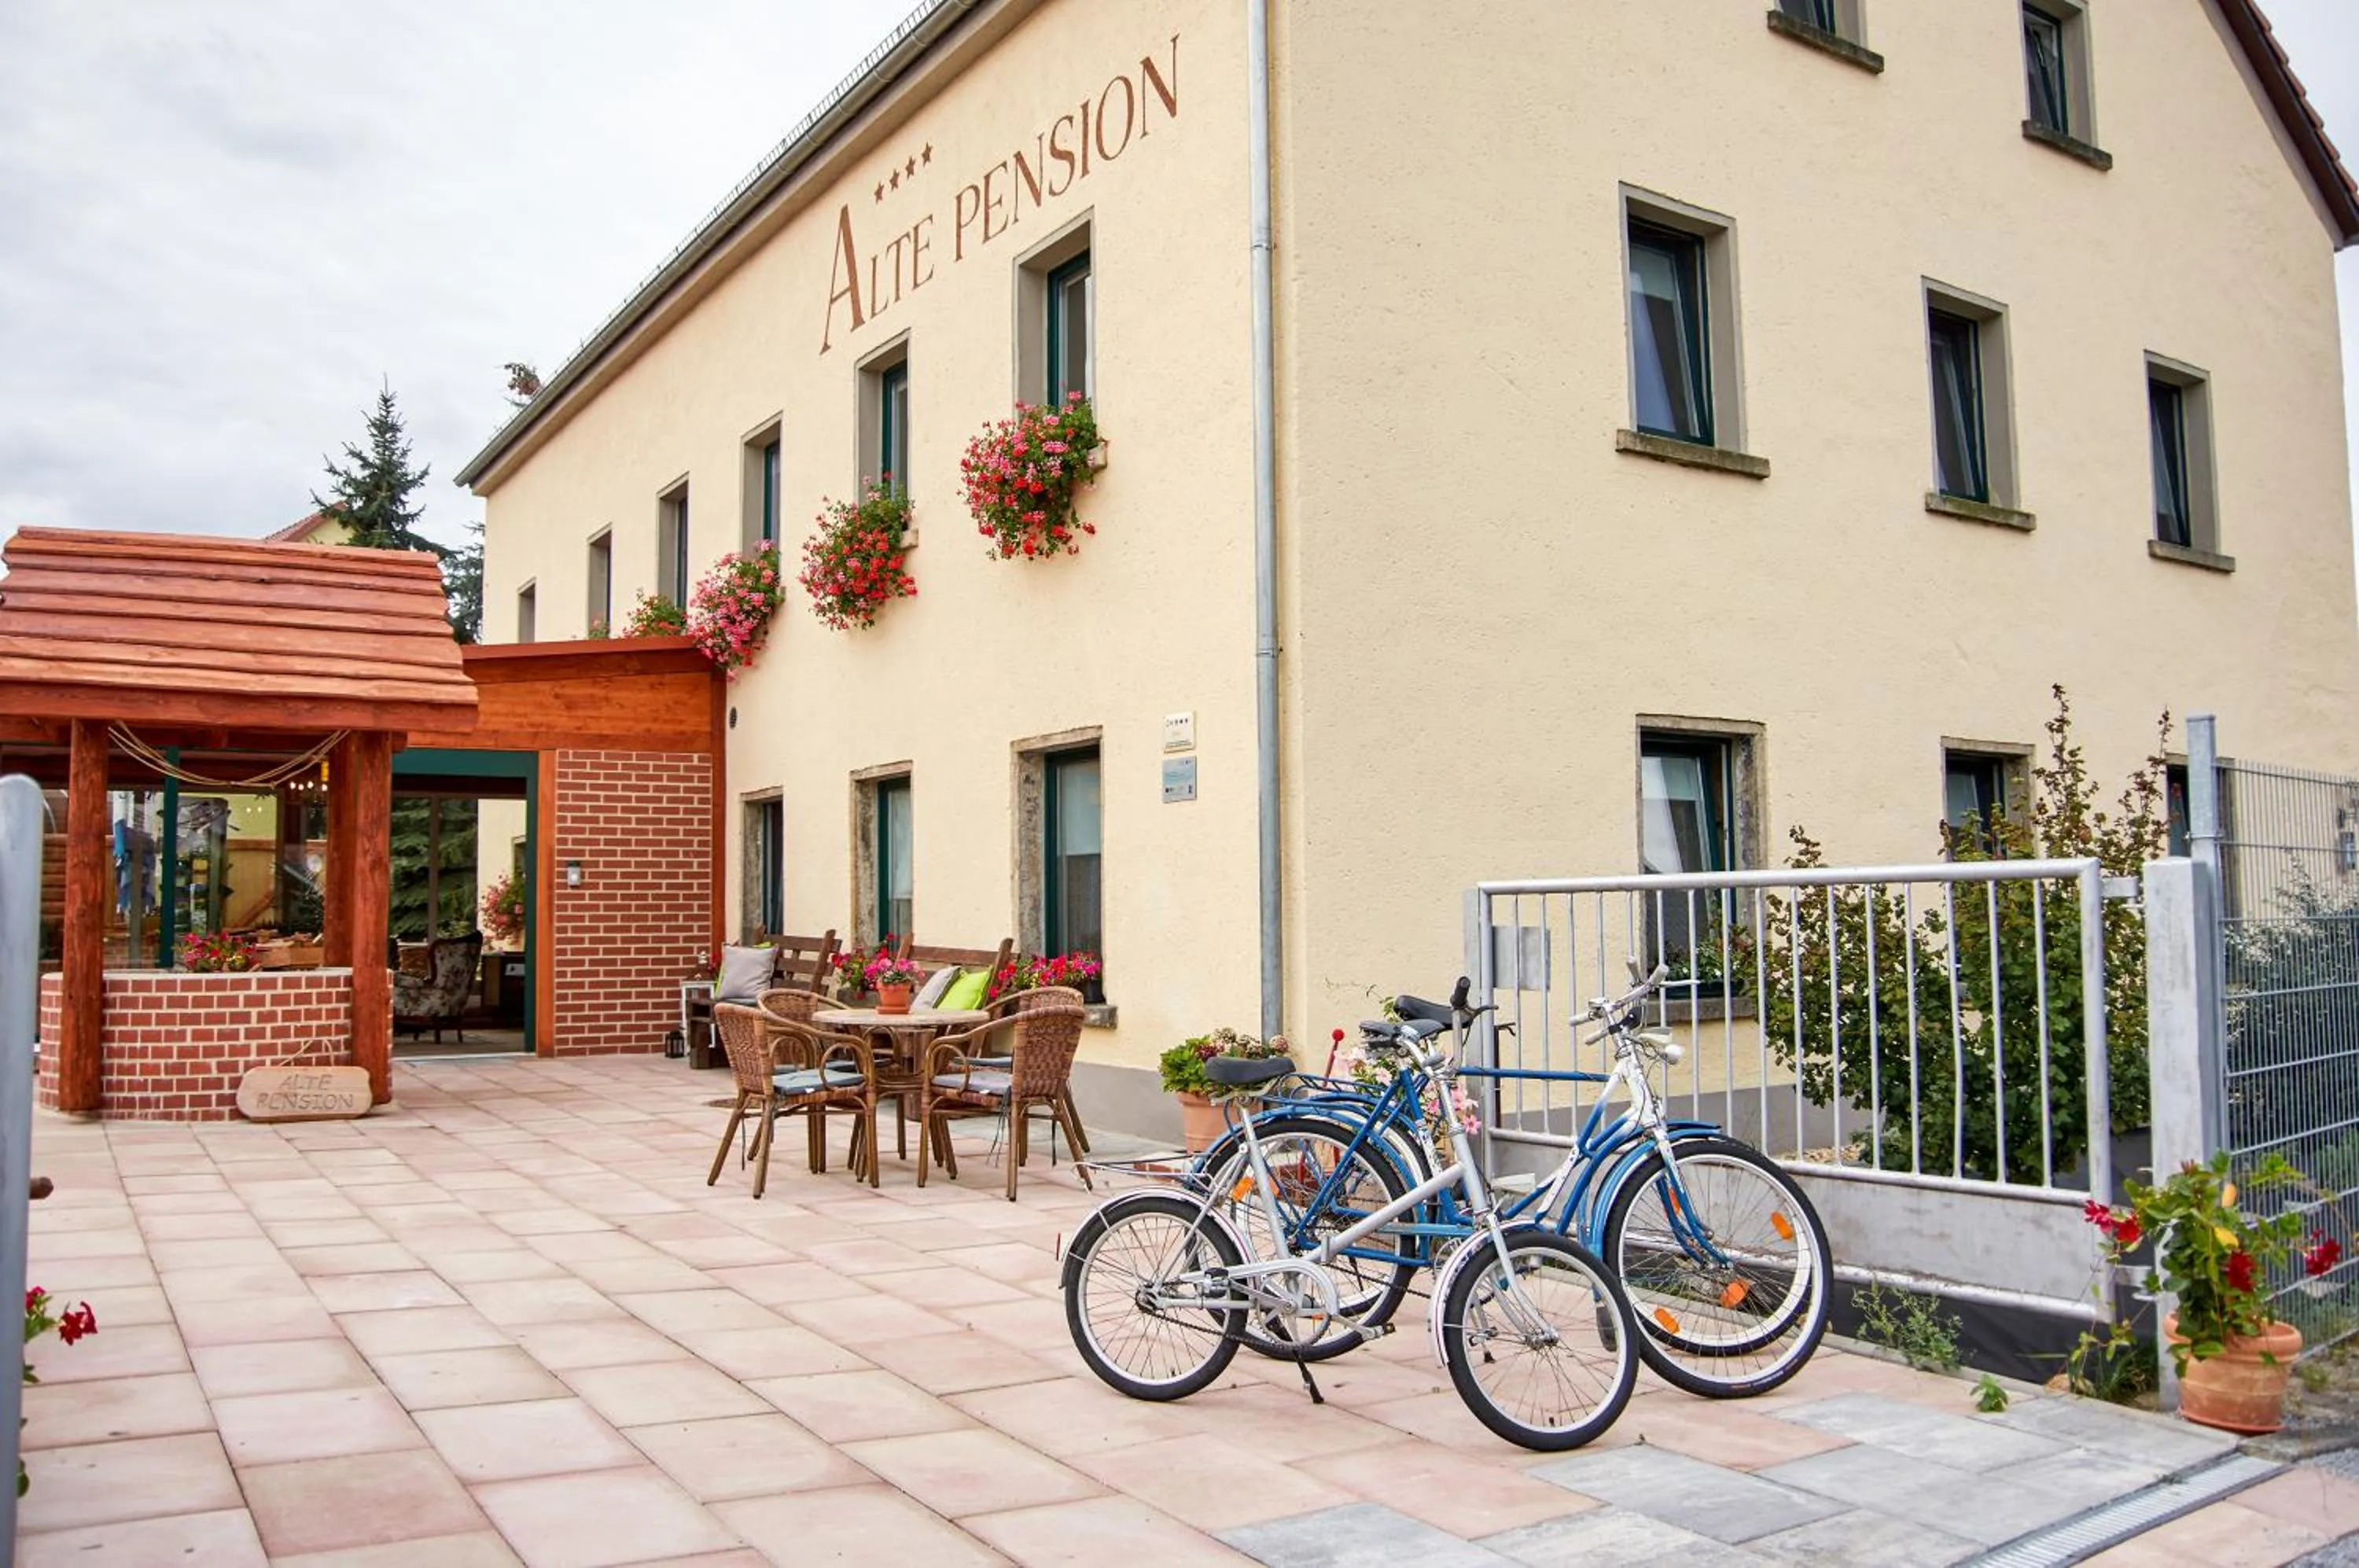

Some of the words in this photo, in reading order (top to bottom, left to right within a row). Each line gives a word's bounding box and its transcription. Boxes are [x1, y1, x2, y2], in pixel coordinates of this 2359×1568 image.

[820, 204, 934, 355] ALTE
[955, 34, 1180, 263] PENSION
[279, 1074, 333, 1091] ALTE
[256, 1093, 353, 1110] PENSION
